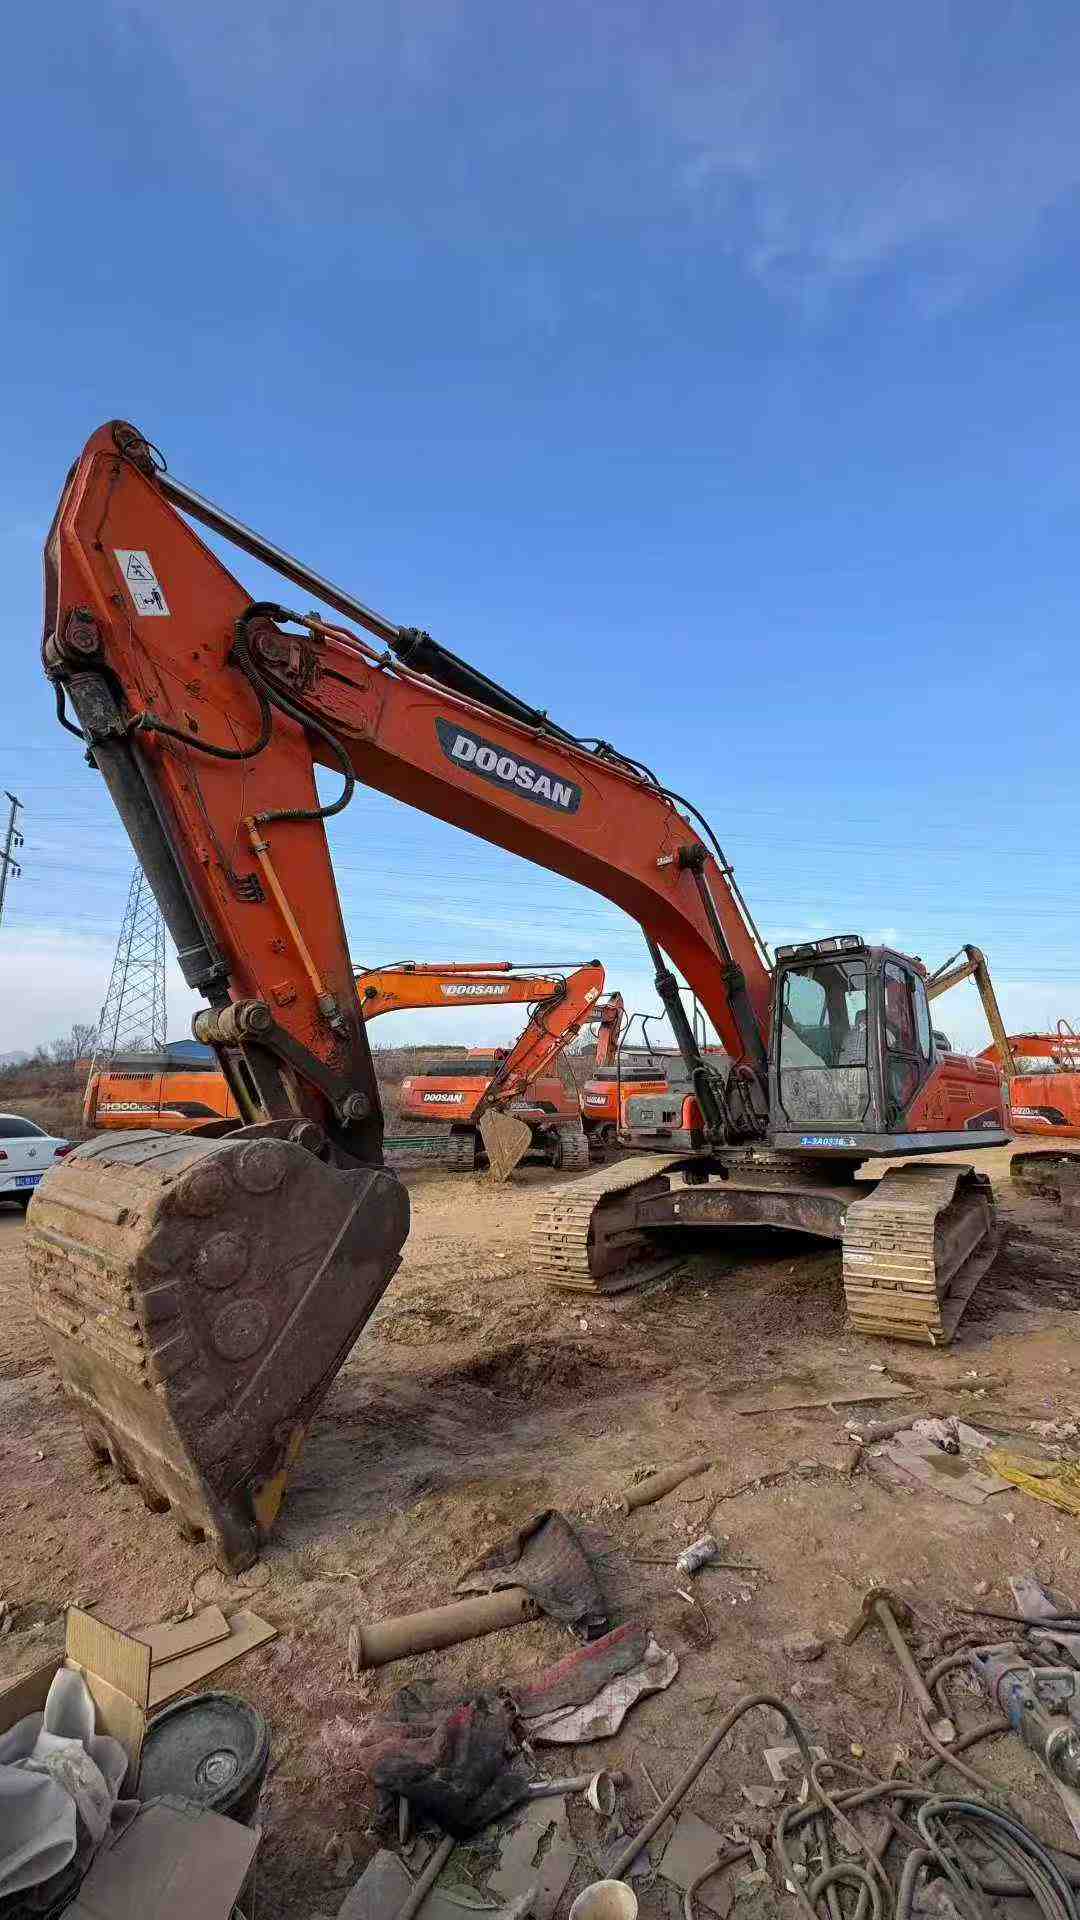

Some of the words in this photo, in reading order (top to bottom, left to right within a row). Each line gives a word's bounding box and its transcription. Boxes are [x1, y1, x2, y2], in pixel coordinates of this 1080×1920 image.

[451, 734, 574, 807] DOOSAN
[446, 985, 505, 996] DOOSAN
[423, 1093, 463, 1103] DOOSAN
